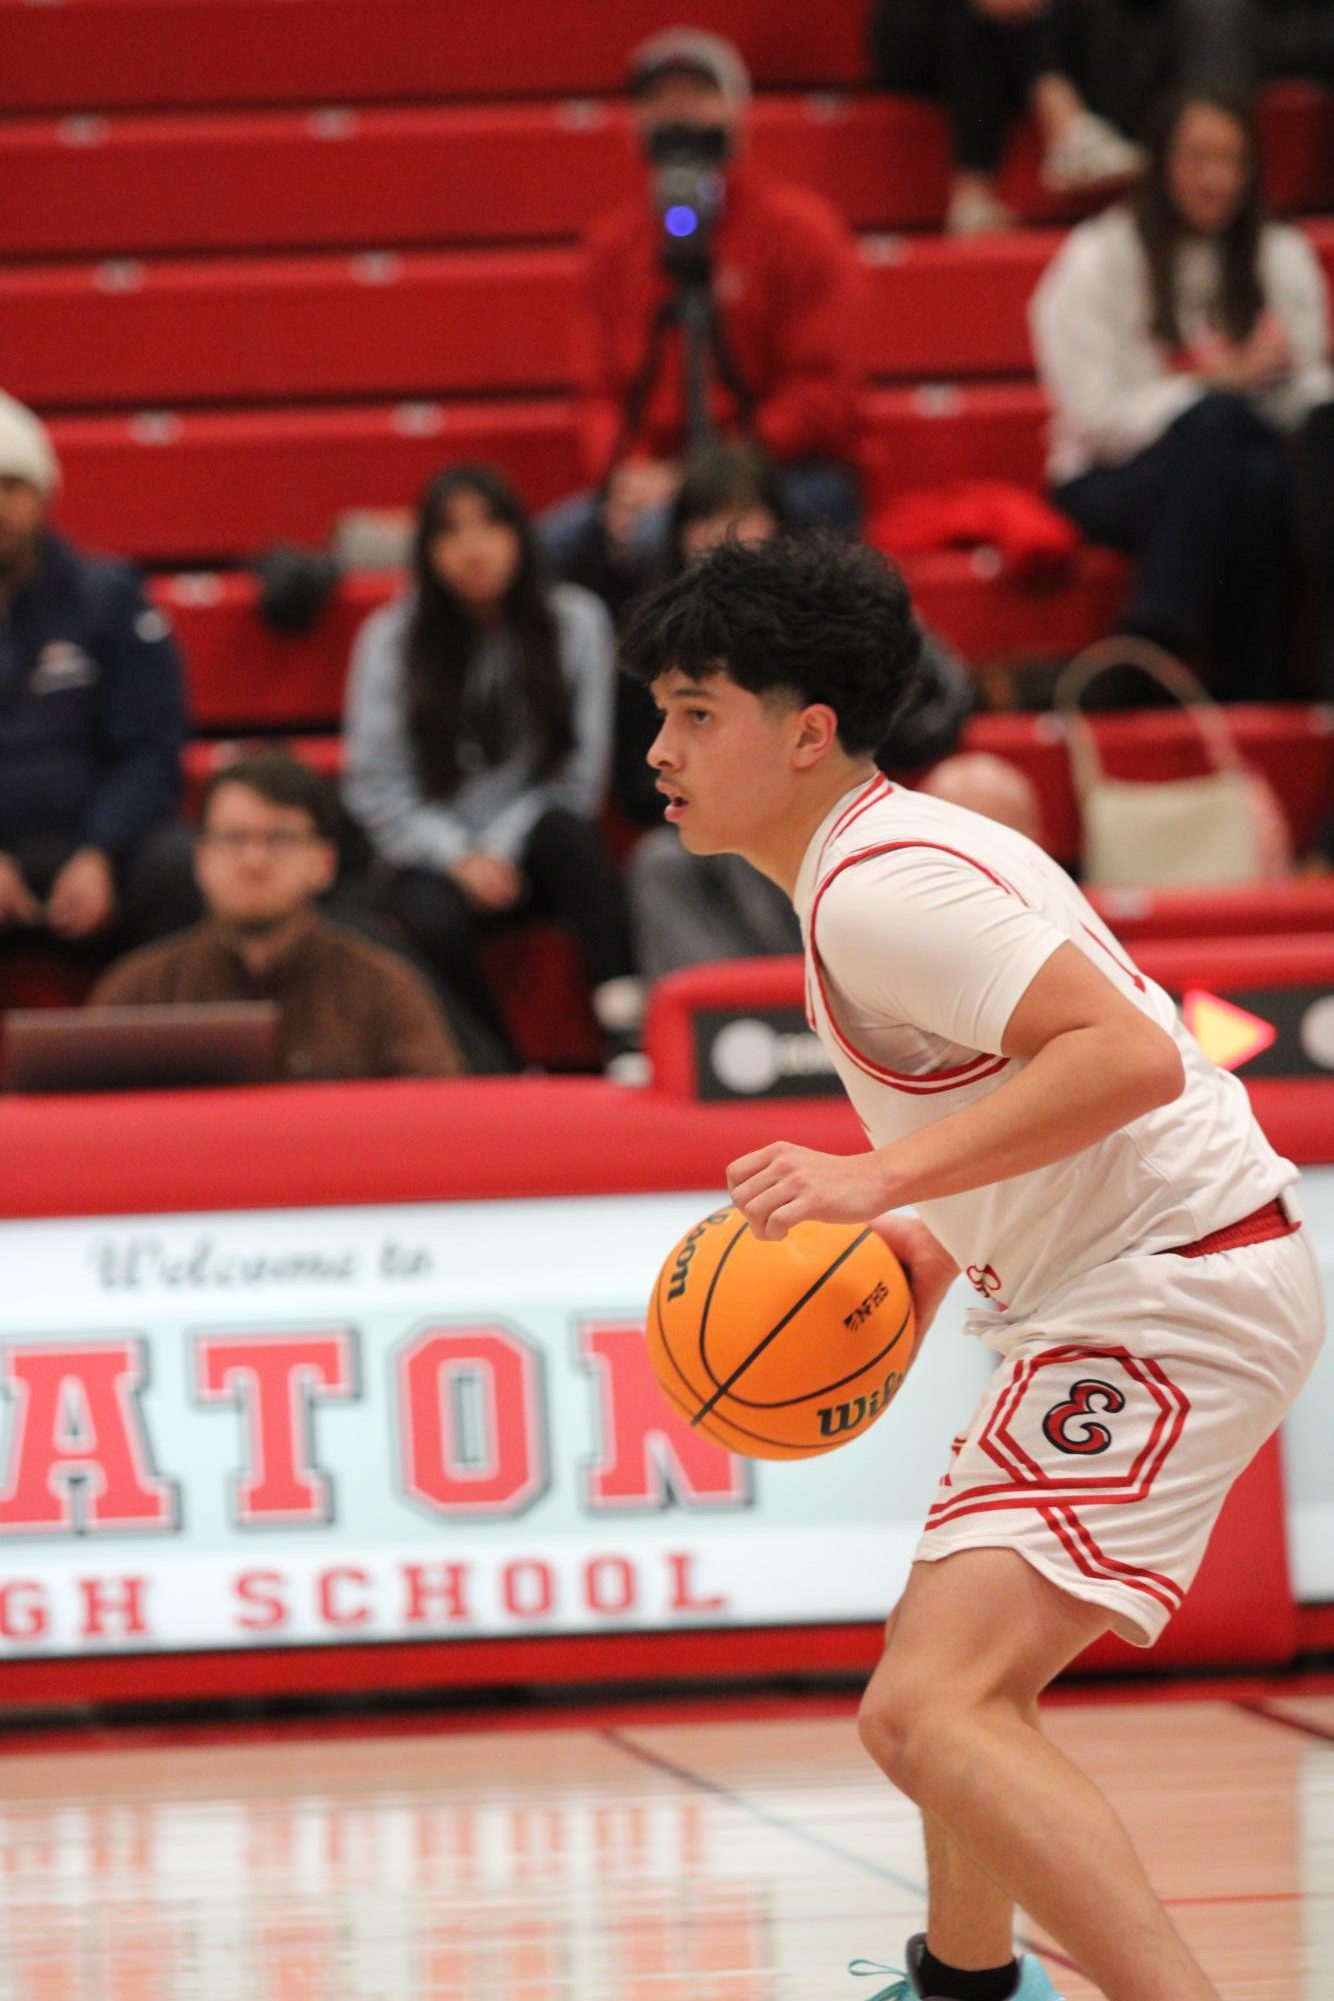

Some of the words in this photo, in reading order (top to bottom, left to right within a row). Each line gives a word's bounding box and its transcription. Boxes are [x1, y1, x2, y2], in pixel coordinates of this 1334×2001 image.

[90, 1235, 360, 1292] Welcome
[378, 1236, 434, 1280] to
[0, 1312, 757, 1537] ATON
[817, 1371, 905, 1436] Wil
[1042, 1378, 1126, 1455] E
[0, 1576, 150, 1640] GH
[232, 1552, 728, 1632] SCHOOL
